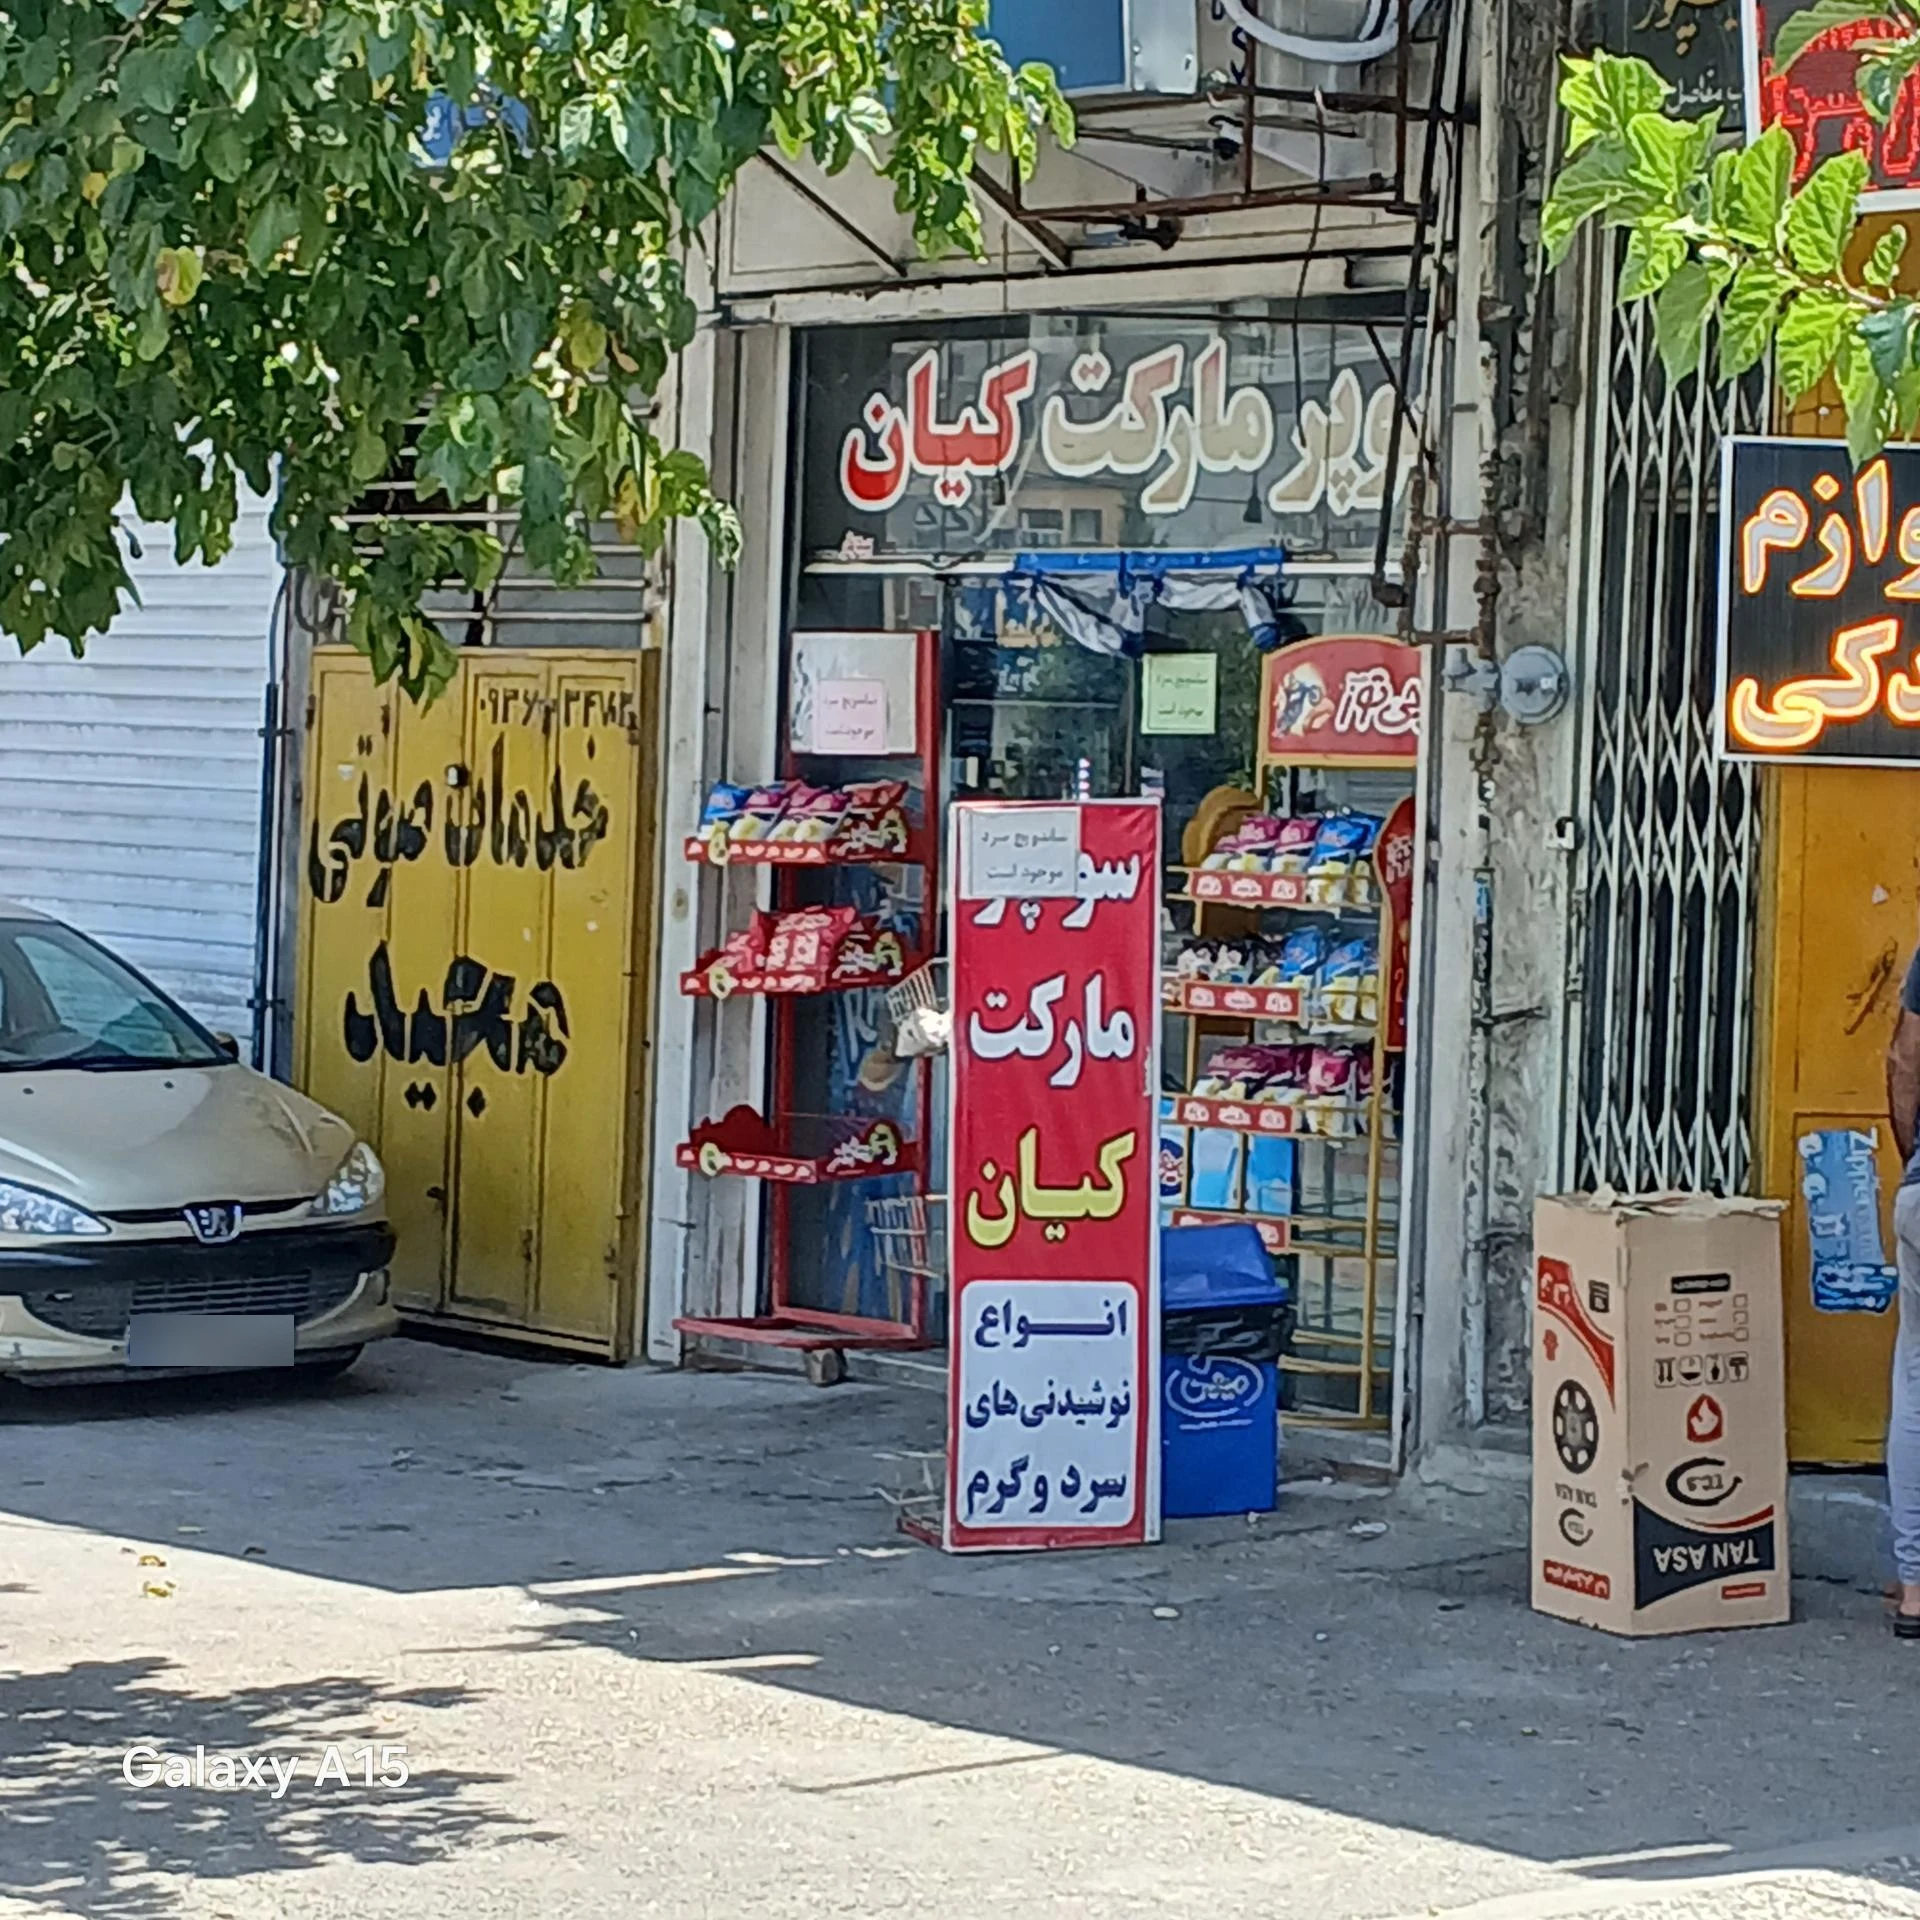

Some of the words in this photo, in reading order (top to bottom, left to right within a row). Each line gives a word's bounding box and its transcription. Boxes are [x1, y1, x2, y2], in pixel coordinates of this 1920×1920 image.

[841, 343, 1038, 513] کیان
[1041, 336, 1274, 514] مارکت
[972, 851, 1141, 930] سو
[970, 973, 1136, 1087] مارکت
[967, 1127, 1136, 1248] کیان
[974, 1298, 1128, 1348] انواع
[1060, 1464, 1128, 1514] سرد
[1653, 1544, 1707, 1574] ASA
[1712, 1538, 1760, 1569] TAN
